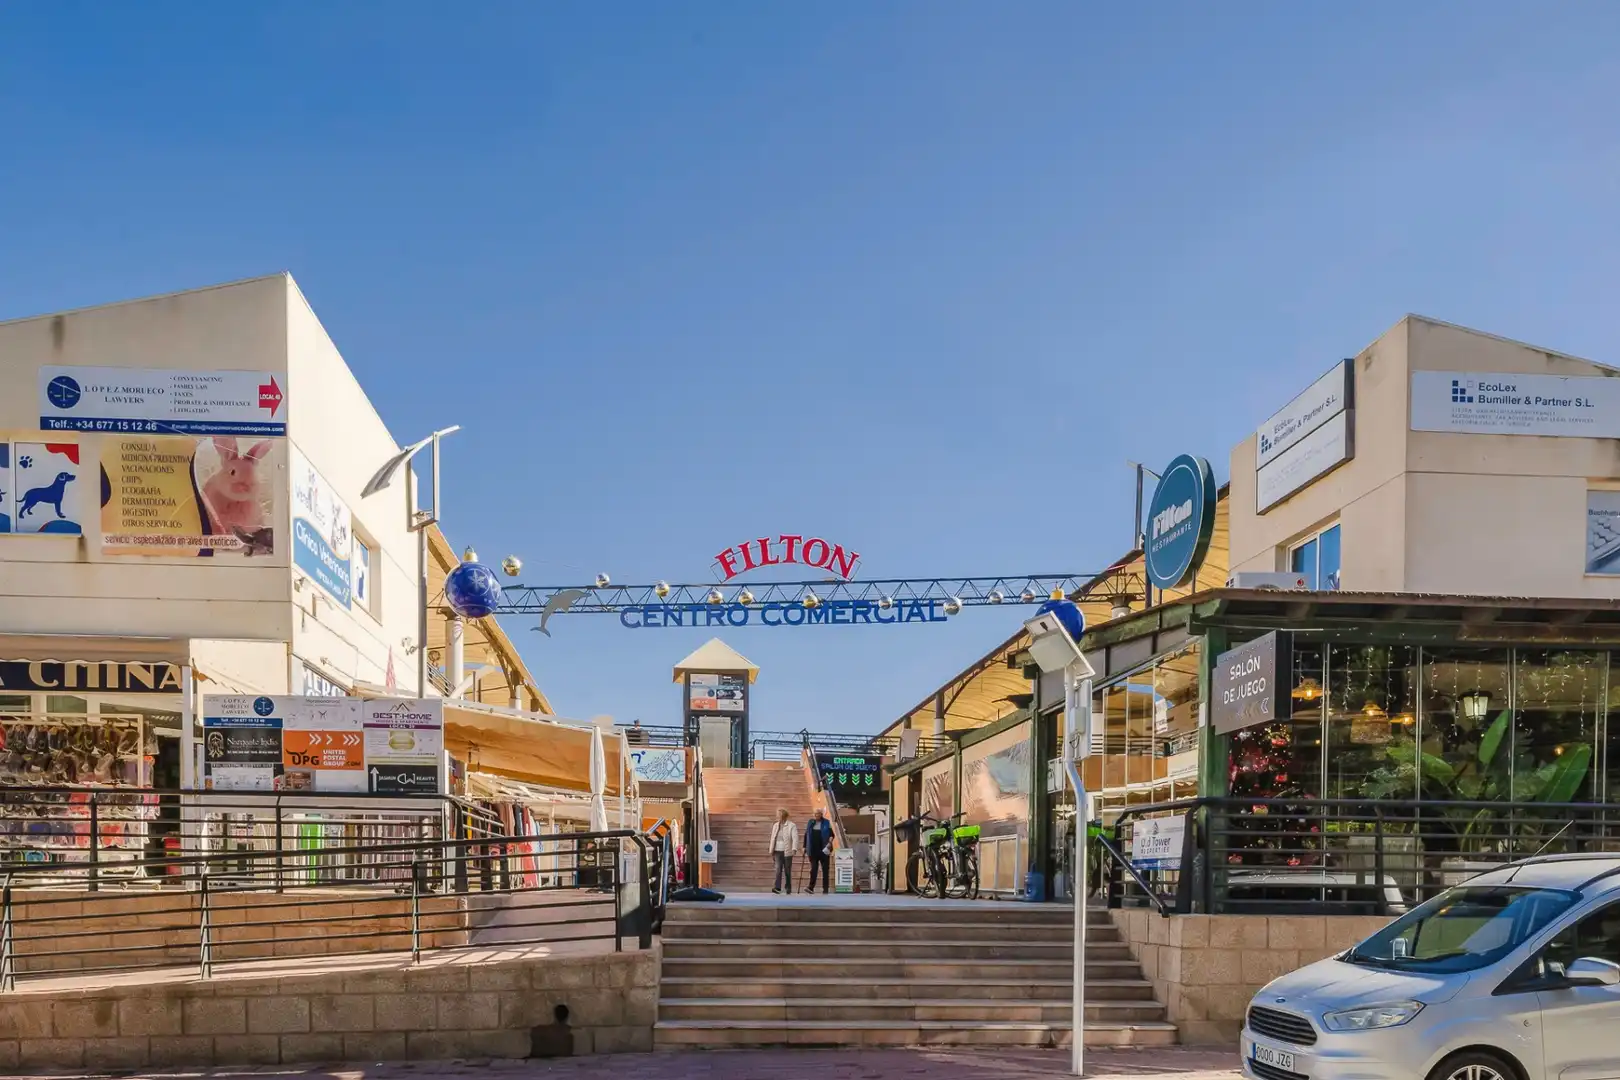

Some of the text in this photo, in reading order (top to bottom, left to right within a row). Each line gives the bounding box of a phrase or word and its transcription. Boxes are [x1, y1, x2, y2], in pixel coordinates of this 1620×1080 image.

[1478, 382, 1516, 392] EcoLex
[104, 396, 145, 404] LAWYERS
[1478, 395, 1595, 408] Bumiller & Partner S.L.
[49, 420, 158, 431] Telf.: +34 677 15 12 46
[121, 454, 153, 462] MEDICINA
[121, 464, 175, 474] VACUNACIONES
[121, 476, 143, 484] CHIPS
[122, 508, 158, 517] DIGESTIVO
[122, 520, 182, 528] OTROS SERVICIOS
[1152, 520, 1192, 552] RESTAURANTE
[714, 534, 860, 580] FILTON
[620, 598, 948, 628] CENTRO COMERCIAL
[1230, 654, 1260, 680] SALÓN
[28, 661, 183, 690] CHINA
[1224, 677, 1266, 704] DE JUEGO
[287, 752, 320, 766] UPG
[1152, 836, 1172, 846] Tower
[1256, 1046, 1290, 1068] 0000 JZG
